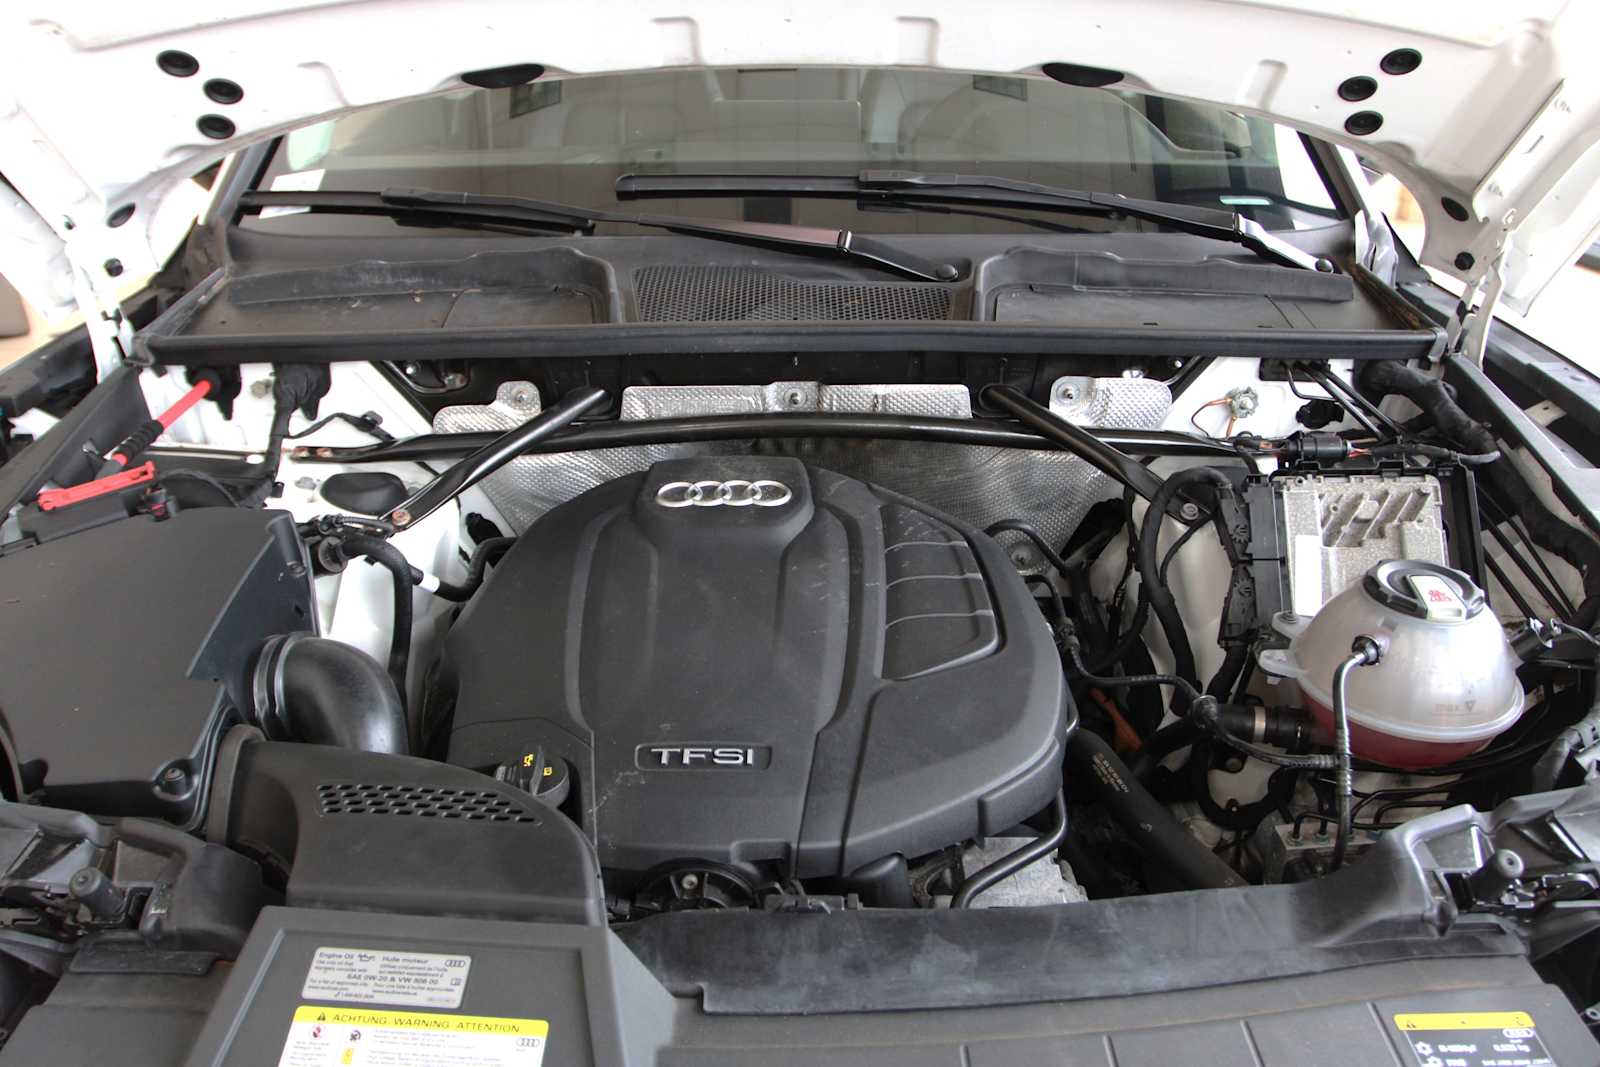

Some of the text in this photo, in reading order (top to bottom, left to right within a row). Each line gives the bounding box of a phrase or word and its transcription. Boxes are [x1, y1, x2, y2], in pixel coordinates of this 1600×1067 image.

[651, 748, 754, 765] TFSI
[333, 1014, 520, 1032] ACHTUNG WARNING ATTENTION
